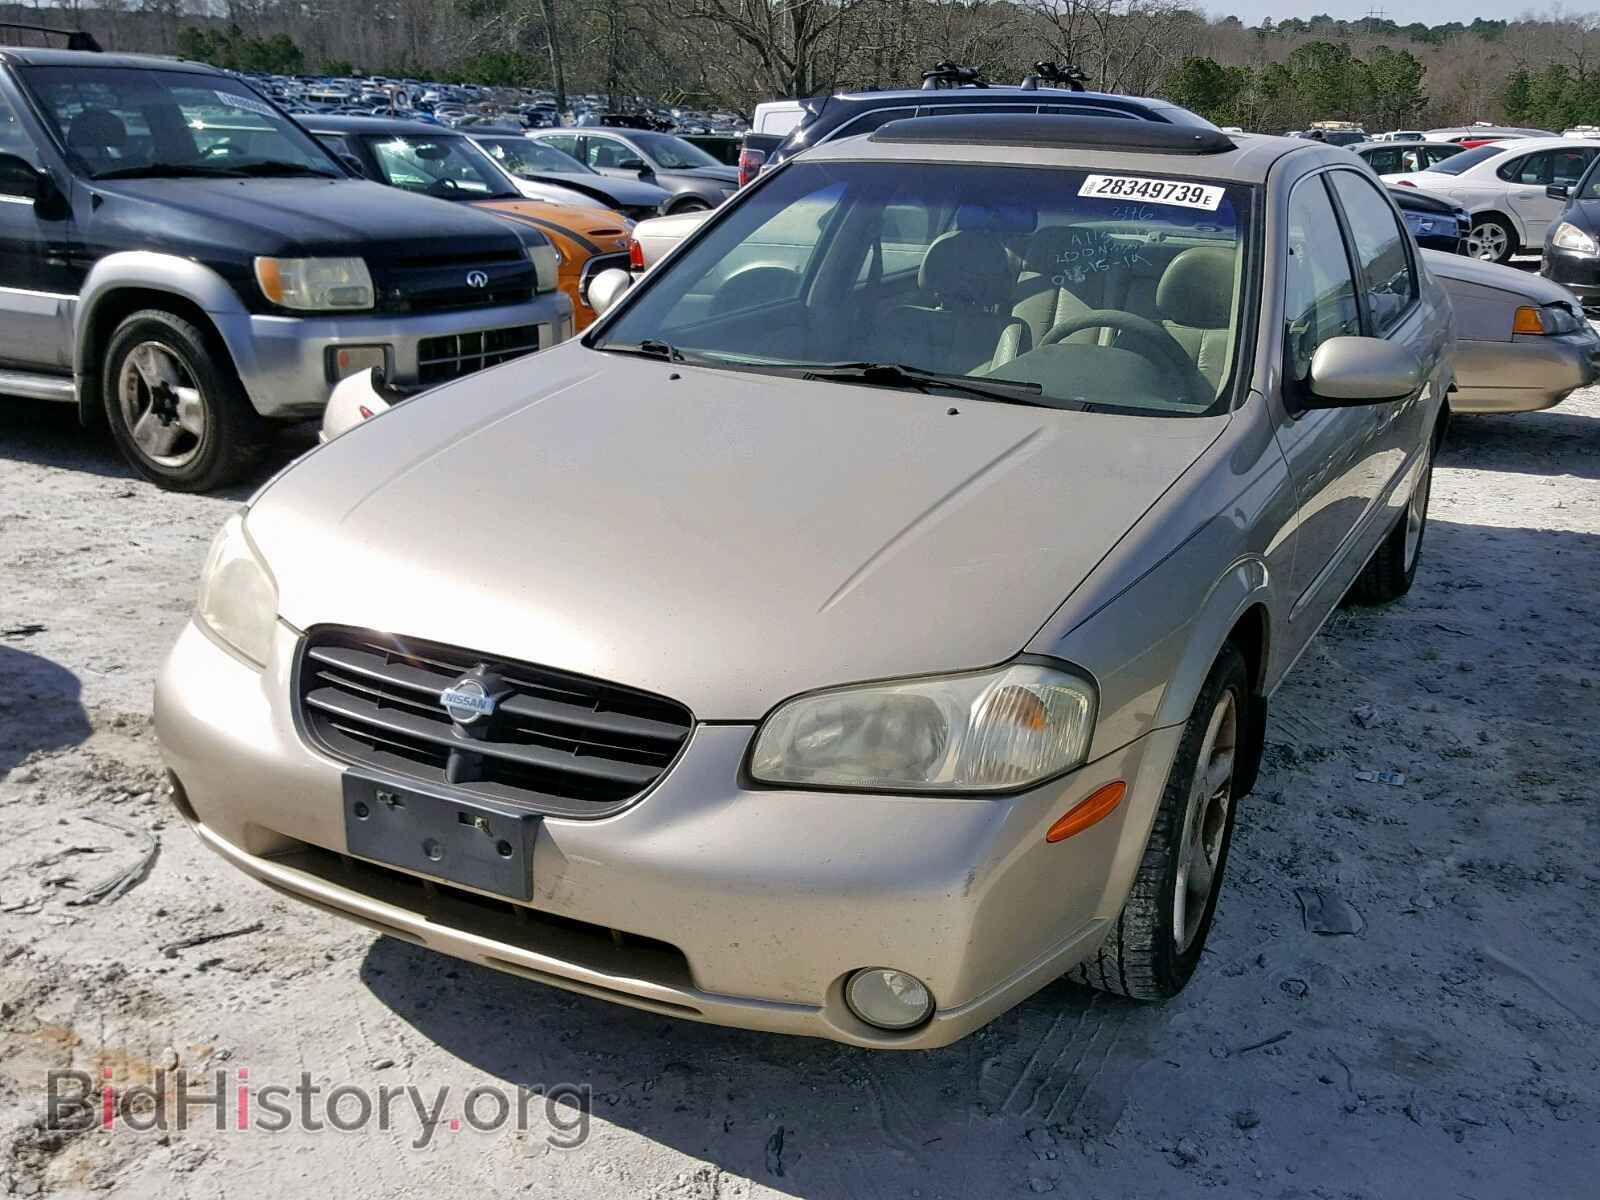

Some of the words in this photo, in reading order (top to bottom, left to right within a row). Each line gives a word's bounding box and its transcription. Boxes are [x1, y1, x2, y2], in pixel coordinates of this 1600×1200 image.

[1097, 178, 1204, 203] 28349739
[1203, 195, 1213, 205] E
[447, 692, 486, 709] NISSAN
